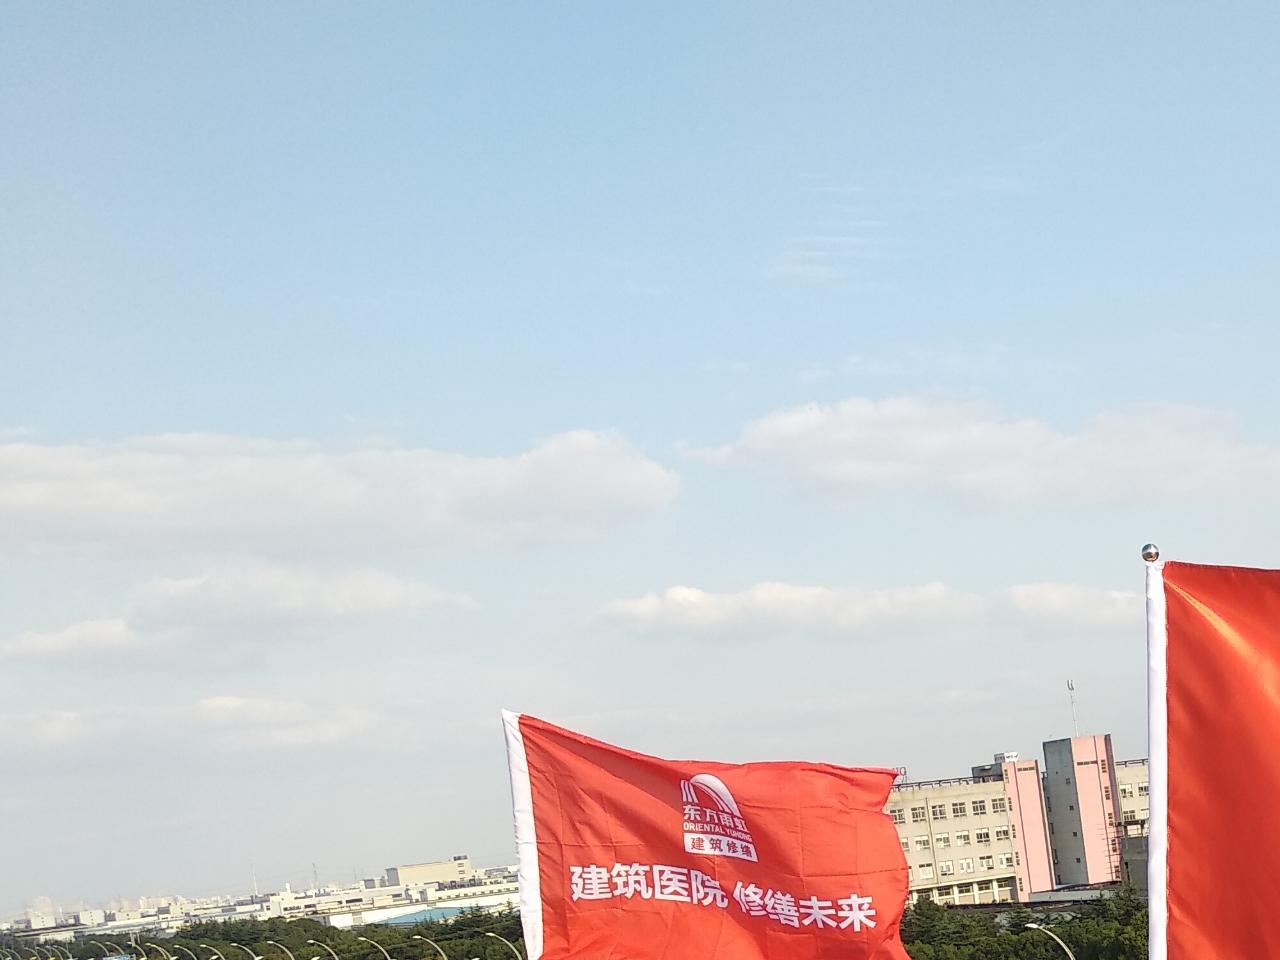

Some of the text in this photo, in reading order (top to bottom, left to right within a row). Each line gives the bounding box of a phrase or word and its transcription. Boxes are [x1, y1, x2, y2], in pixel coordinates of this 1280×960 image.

[682, 804, 751, 833] 东方雨虹
[683, 821, 726, 834] ORIENTAL
[569, 862, 877, 933] 建筑医院 修缮未来
